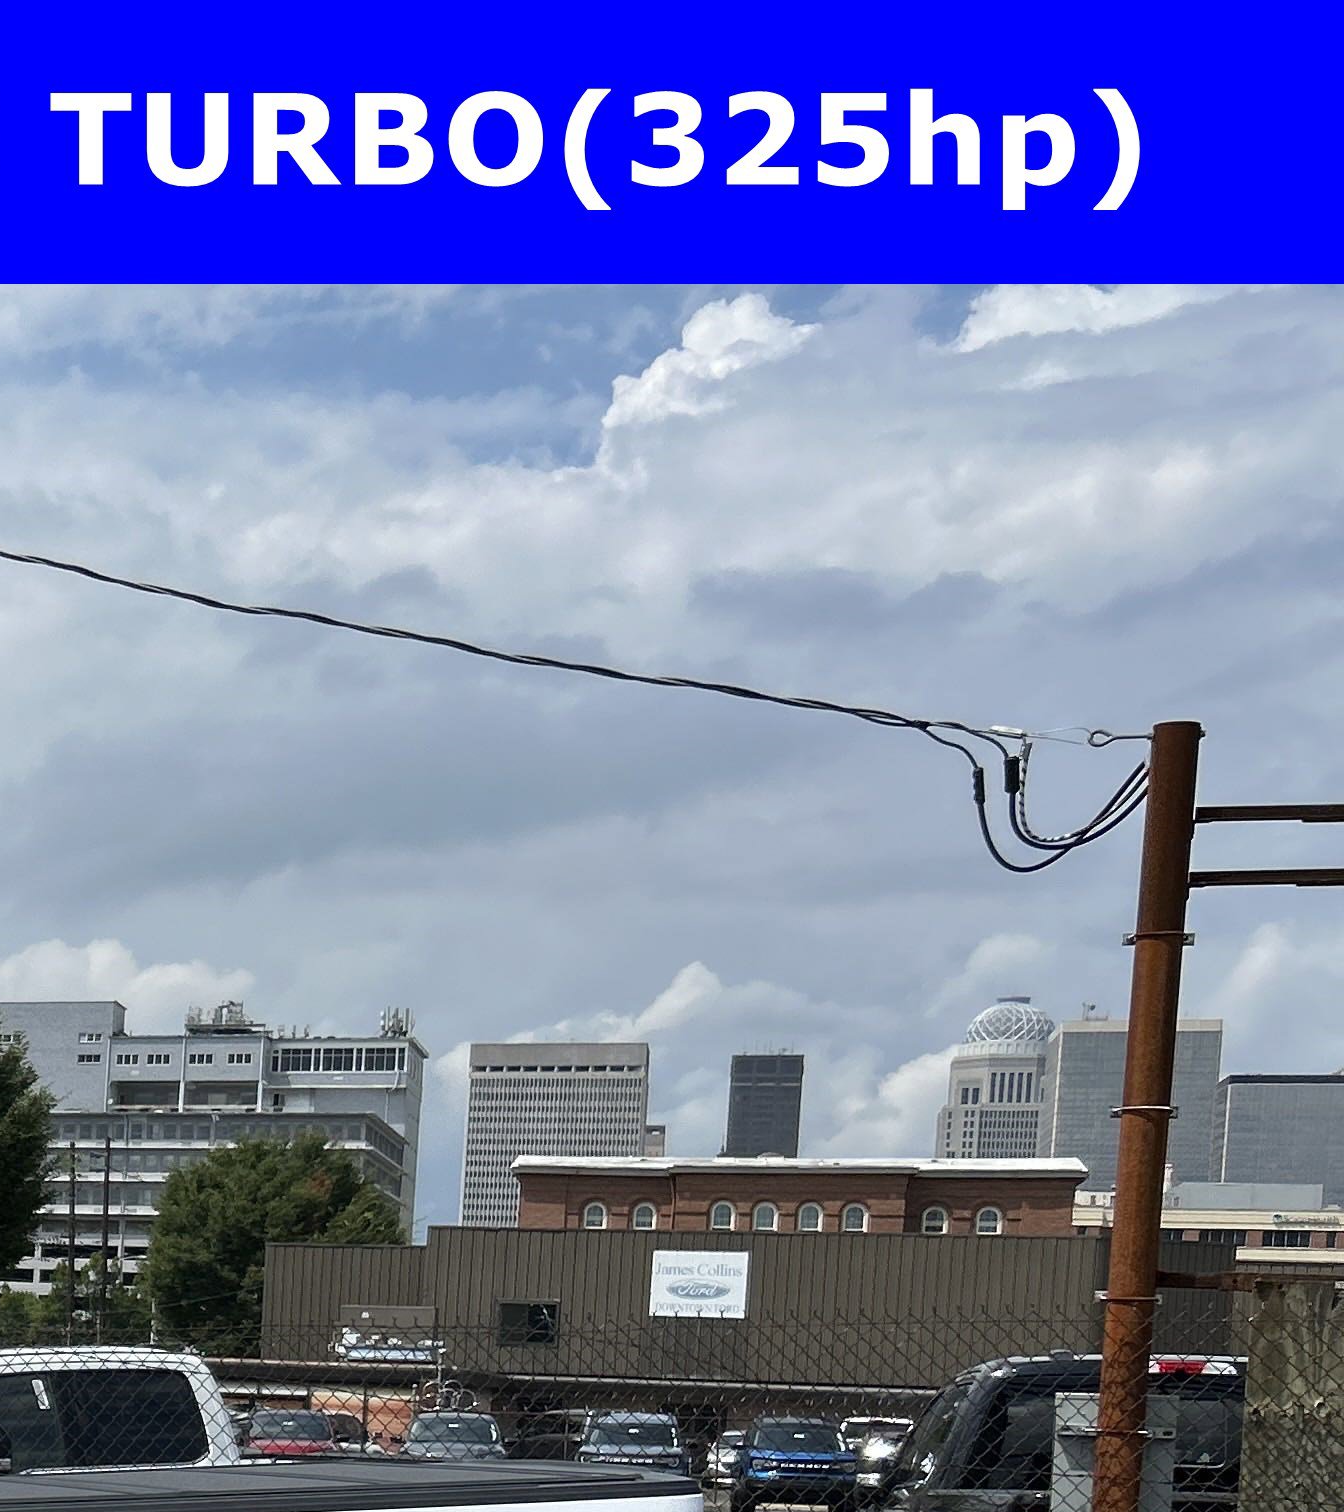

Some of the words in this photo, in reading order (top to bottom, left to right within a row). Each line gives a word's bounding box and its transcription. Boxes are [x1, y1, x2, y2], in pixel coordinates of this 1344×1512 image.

[655, 1262, 693, 1276] James
[697, 1264, 743, 1278] Collins
[677, 1282, 719, 1297] Ford
